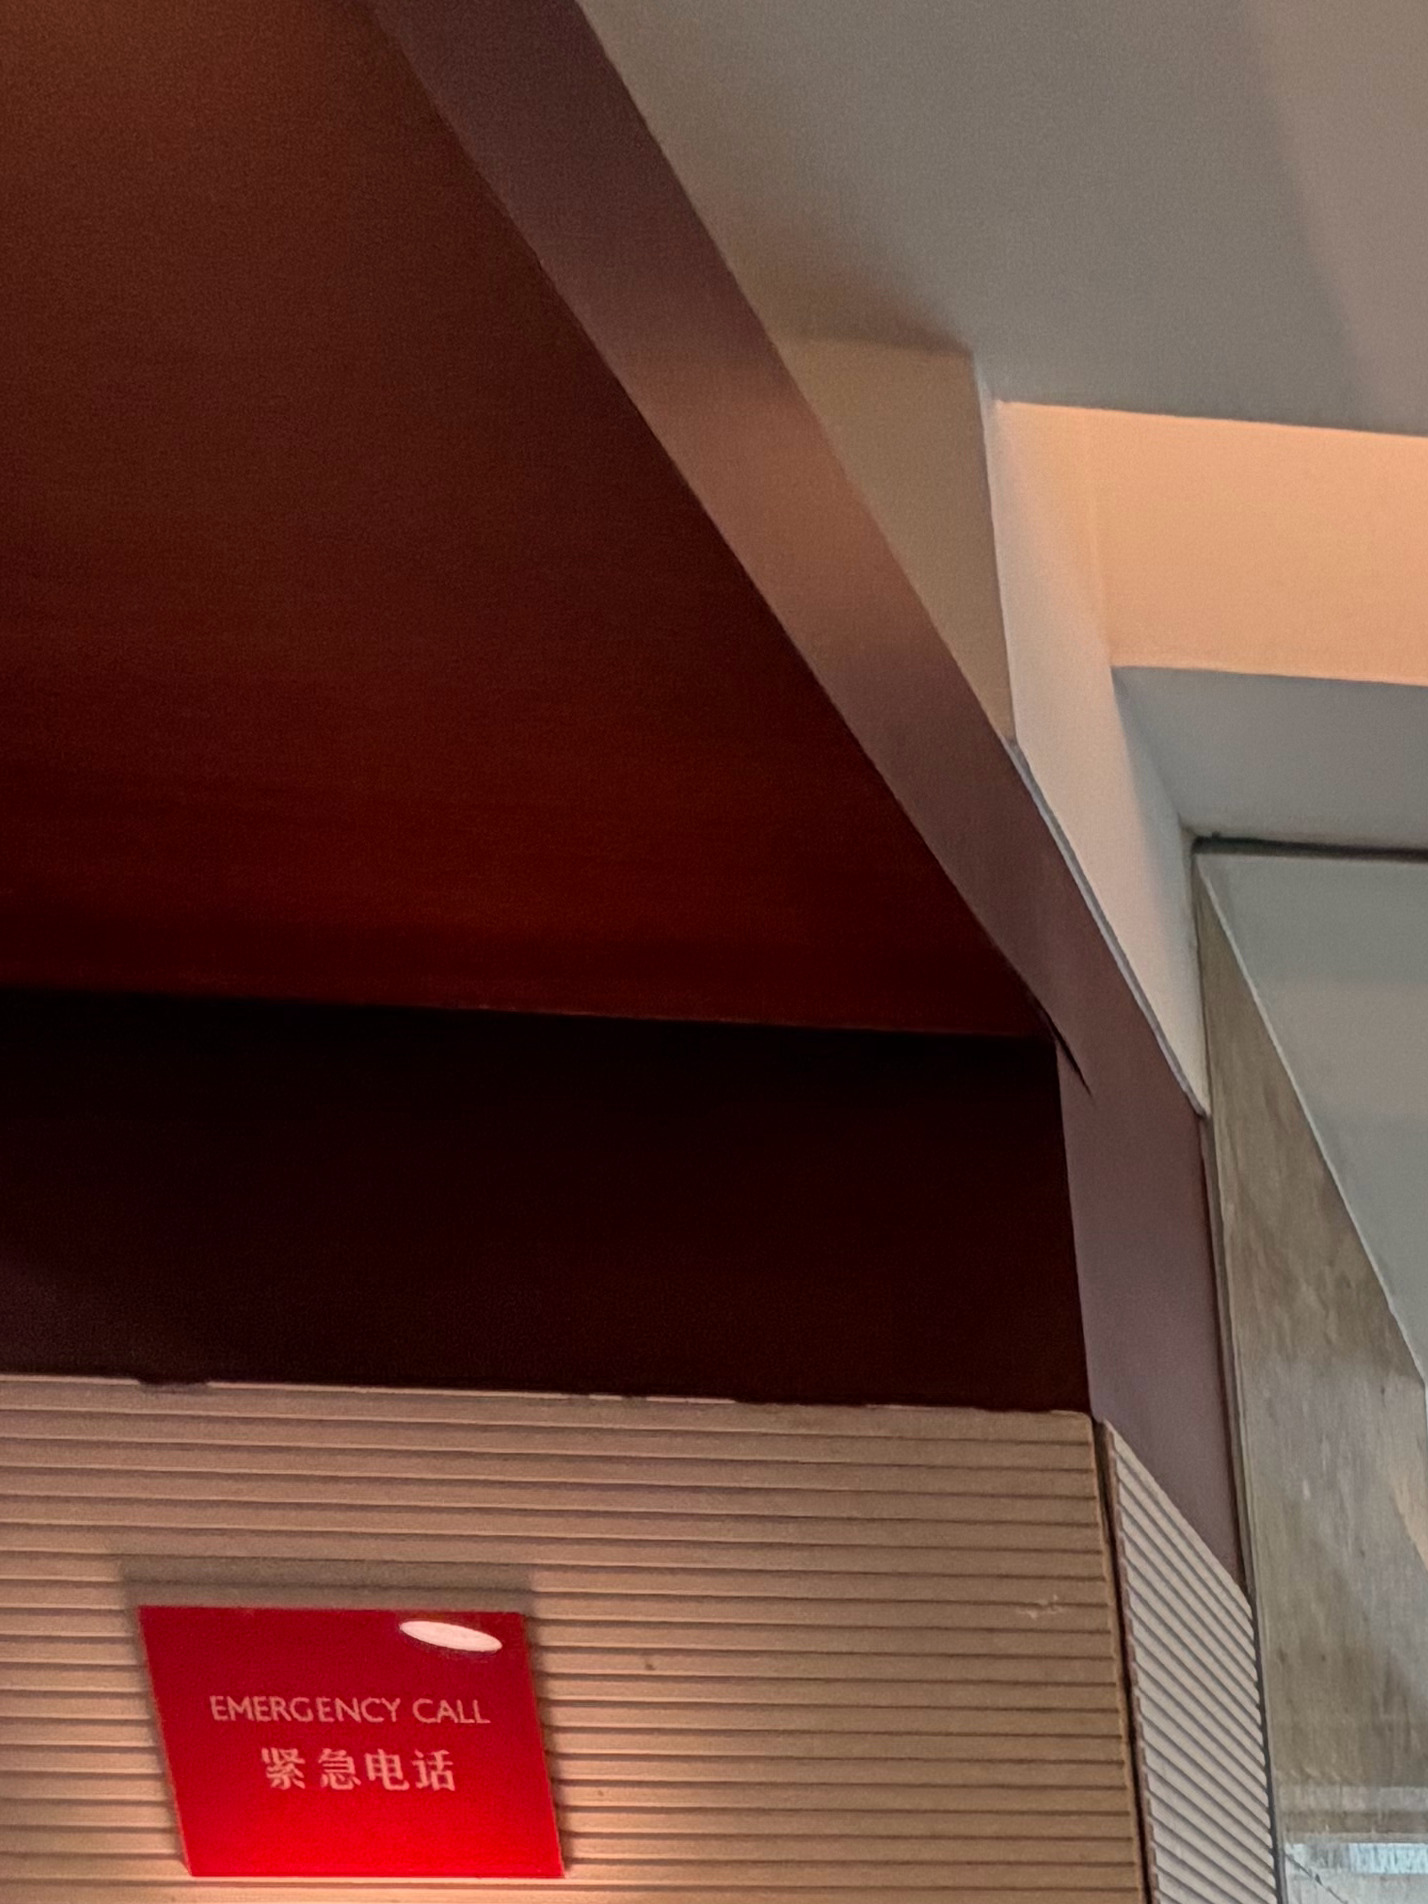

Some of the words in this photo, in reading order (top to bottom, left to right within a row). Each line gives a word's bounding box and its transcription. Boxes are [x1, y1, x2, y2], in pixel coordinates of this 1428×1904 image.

[209, 1695, 401, 1724] EMERGENCY
[412, 1698, 491, 1724] CALL
[260, 1747, 456, 1791] 紧急电话
